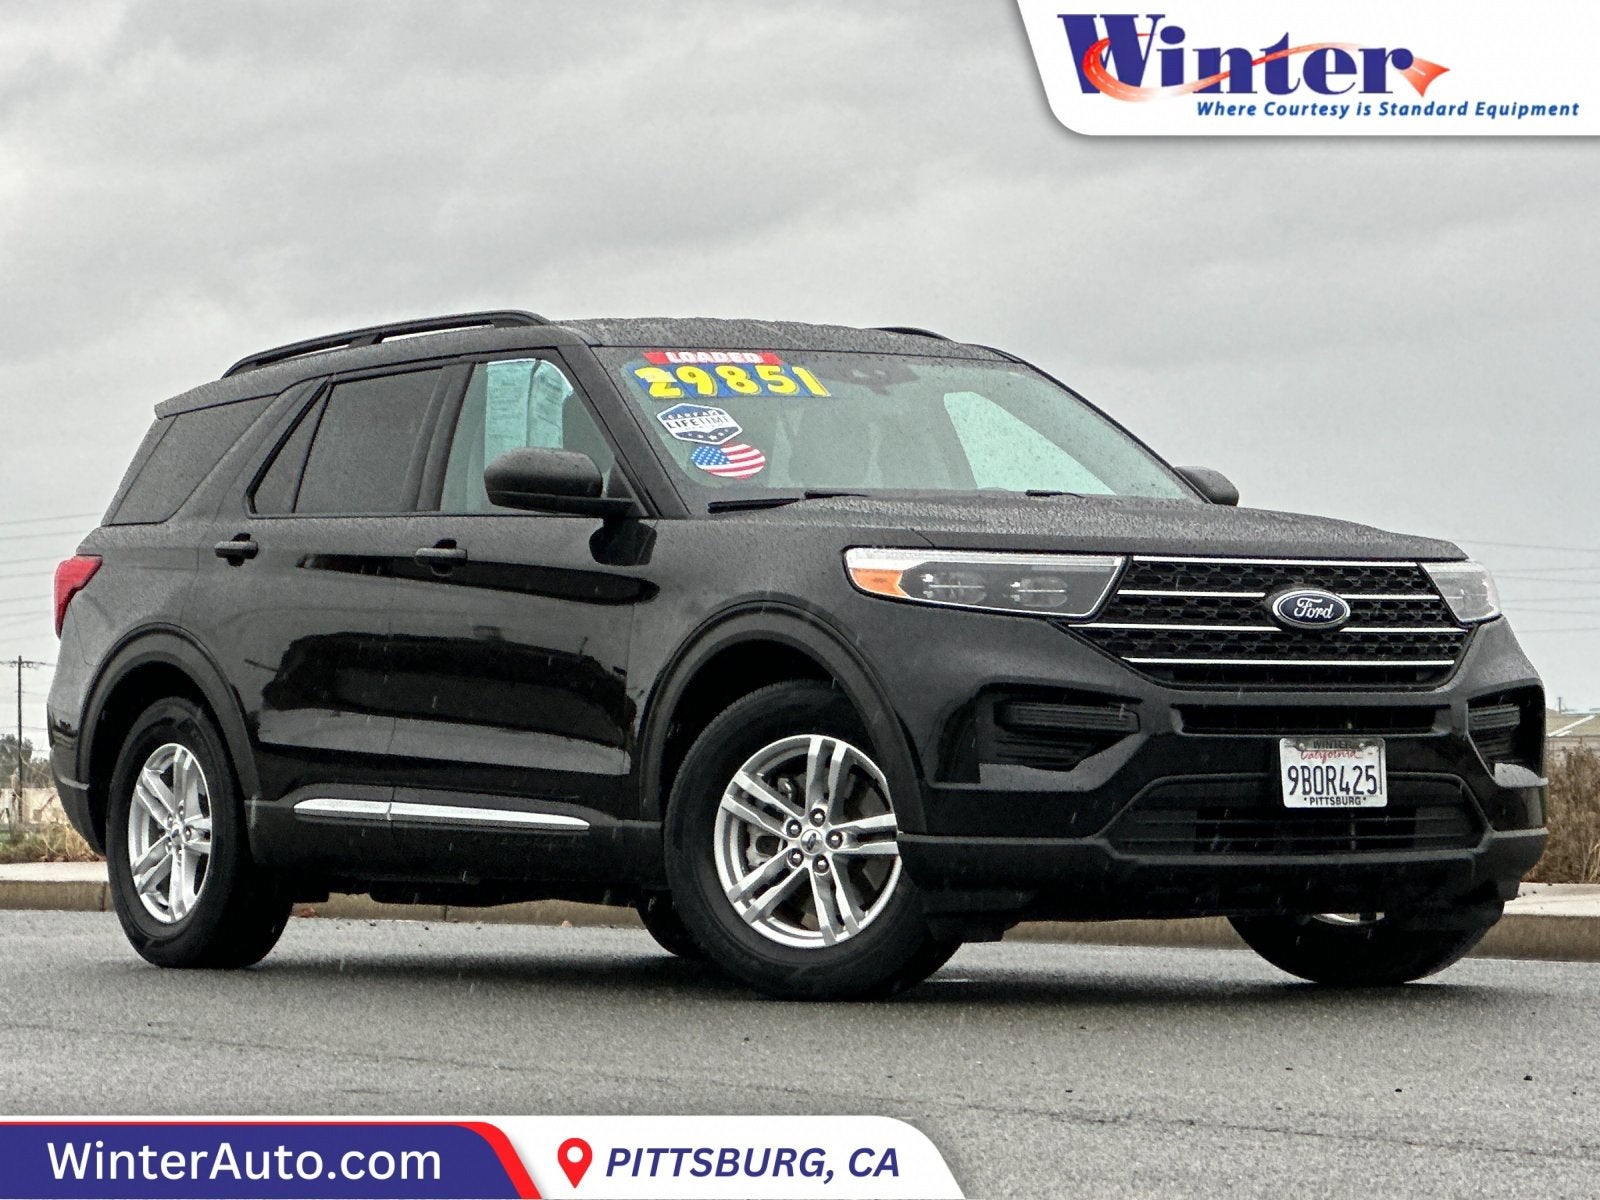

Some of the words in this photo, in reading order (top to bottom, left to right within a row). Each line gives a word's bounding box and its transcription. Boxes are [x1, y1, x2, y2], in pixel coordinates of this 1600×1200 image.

[664, 351, 765, 363] LOADED
[634, 364, 832, 399] 29851
[1293, 597, 1334, 619] Ford
[1309, 796, 1362, 806] PITTSBURG
